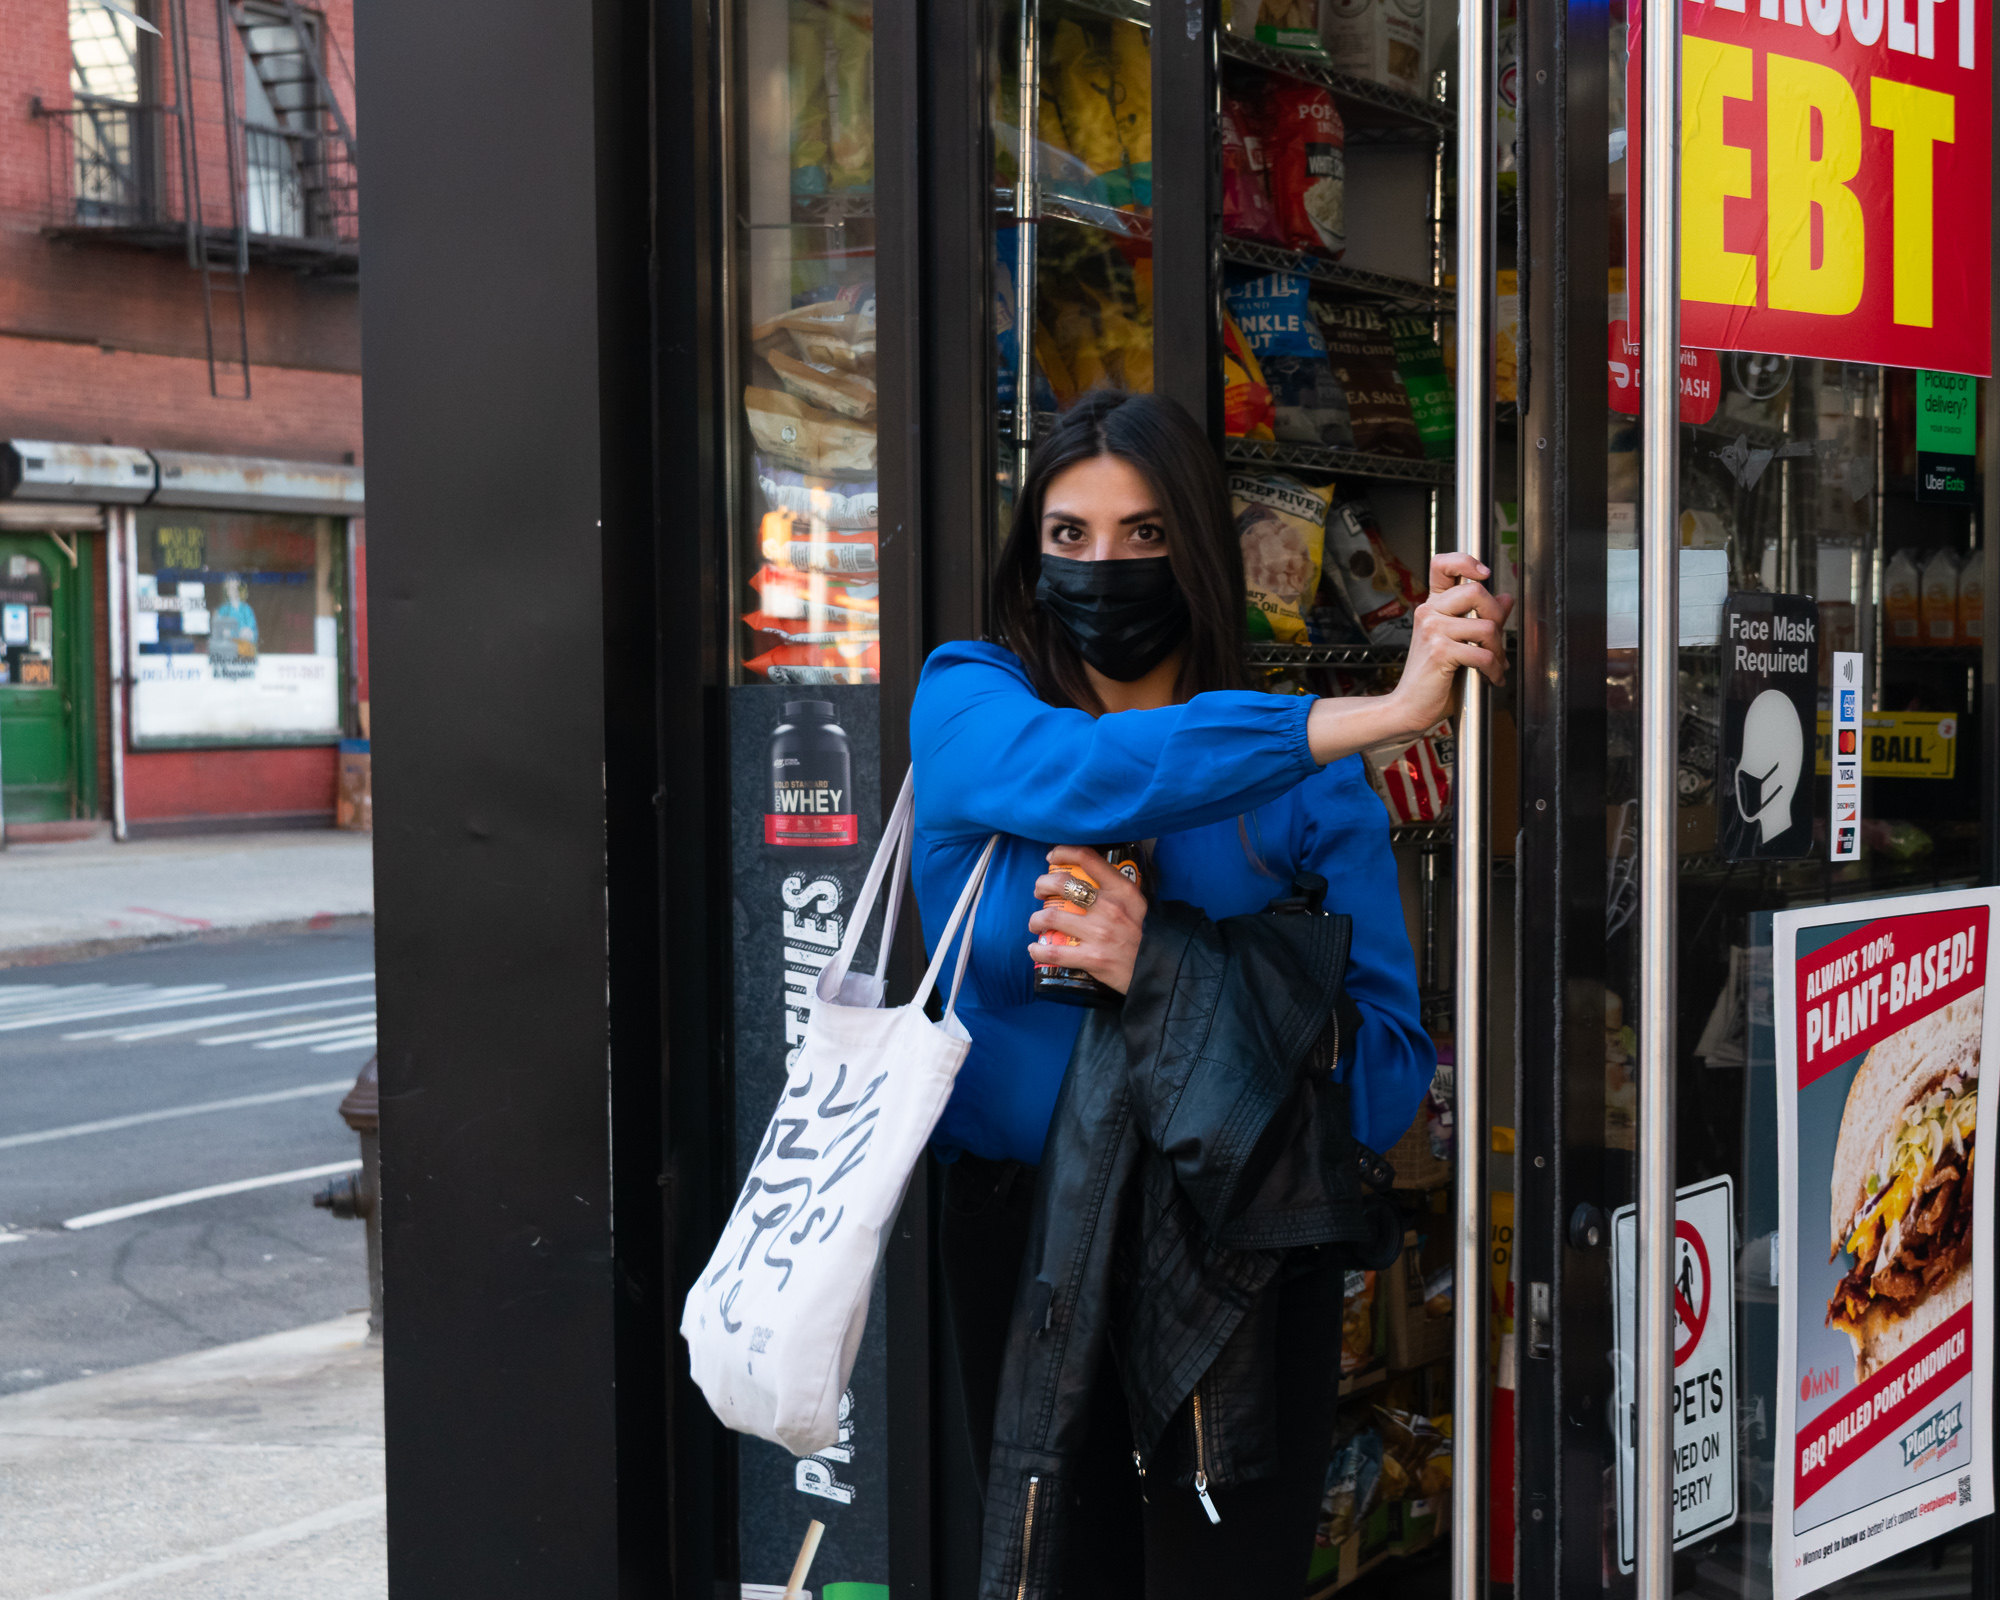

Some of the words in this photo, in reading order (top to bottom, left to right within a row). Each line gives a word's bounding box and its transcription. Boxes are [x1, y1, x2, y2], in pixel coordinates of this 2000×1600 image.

[1681, 34, 1955, 328] EBT
[1246, 333, 1272, 350] UT
[1925, 370, 1956, 394] Pickup
[1957, 377, 1968, 392] or
[1346, 391, 1370, 405] EA
[1372, 391, 1408, 406] SALT
[1925, 394, 1968, 420] delivery?
[1925, 473, 1945, 491] Uber
[1945, 475, 1965, 491] Eats
[1231, 477, 1275, 498] DEEP
[1276, 490, 1326, 517] RIVER
[1262, 601, 1278, 614] Oil
[1730, 613, 1769, 641] Face
[1773, 615, 1815, 643] Mask
[142, 666, 203, 682] DELIVERY
[221, 667, 257, 681] Repair
[1735, 645, 1809, 678] Required
[773, 781, 789, 789] GOLD
[1839, 769, 1854, 781] VISA
[780, 789, 843, 813] WHEY
[1806, 949, 1859, 1002] ALWAYS
[1861, 931, 1895, 972] 100%
[1806, 925, 1976, 1063] PLANT-BASED!
[1802, 1435, 1827, 1477] BBQ
[1828, 1400, 1872, 1455] PULLED
[1873, 1373, 1906, 1421] PORK
[1907, 1328, 1965, 1395] SANDWICH
[1702, 1431, 1720, 1462] ON
[1803, 1548, 1822, 1566] Wanna
[1822, 1542, 1834, 1559] get
[1834, 1540, 1841, 1552] to
[1841, 1533, 1859, 1549] know
[1859, 1530, 1867, 1541] us
[1867, 1518, 1885, 1538] better?
[1885, 1513, 1898, 1530] Let's
[1898, 1506, 1918, 1525] connect
